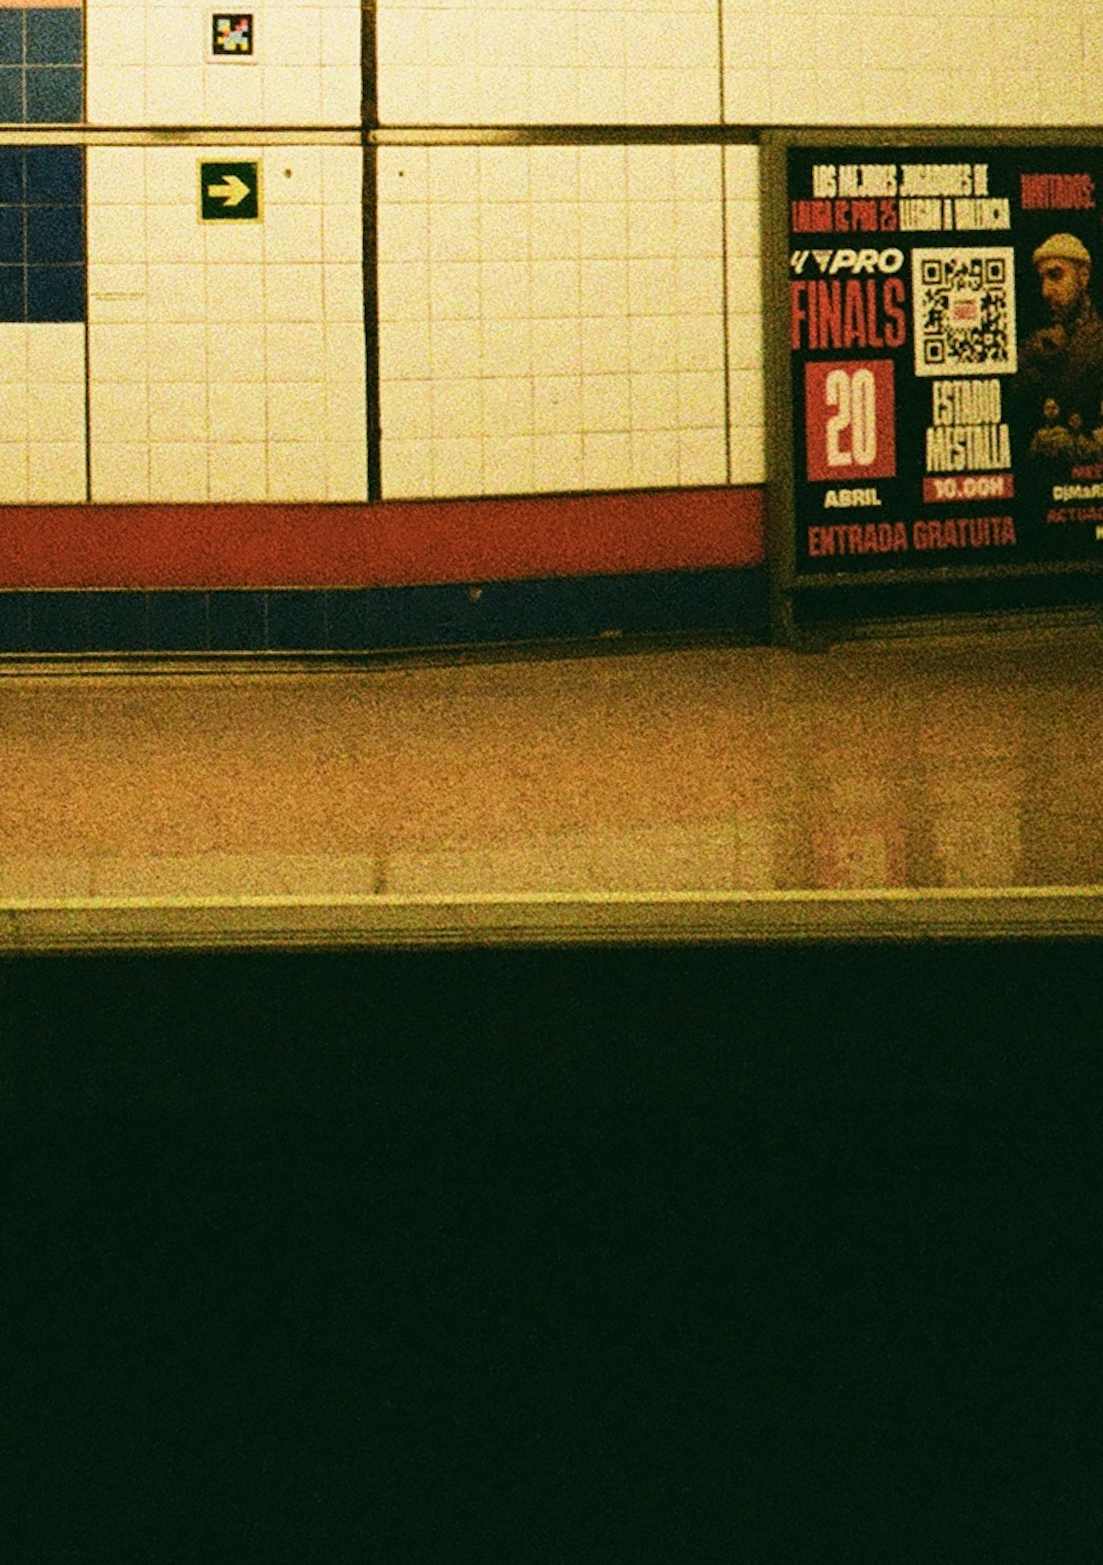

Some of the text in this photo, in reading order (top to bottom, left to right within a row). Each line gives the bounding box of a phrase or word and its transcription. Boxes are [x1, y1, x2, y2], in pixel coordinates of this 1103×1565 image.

[790, 277, 906, 351] FINALS
[825, 369, 876, 468] 20
[932, 379, 1001, 426] ESTADIO
[925, 424, 1011, 472] MESTALLA
[823, 488, 881, 509] ABRIL
[808, 516, 1017, 557] ENTRADA GRATUITA
